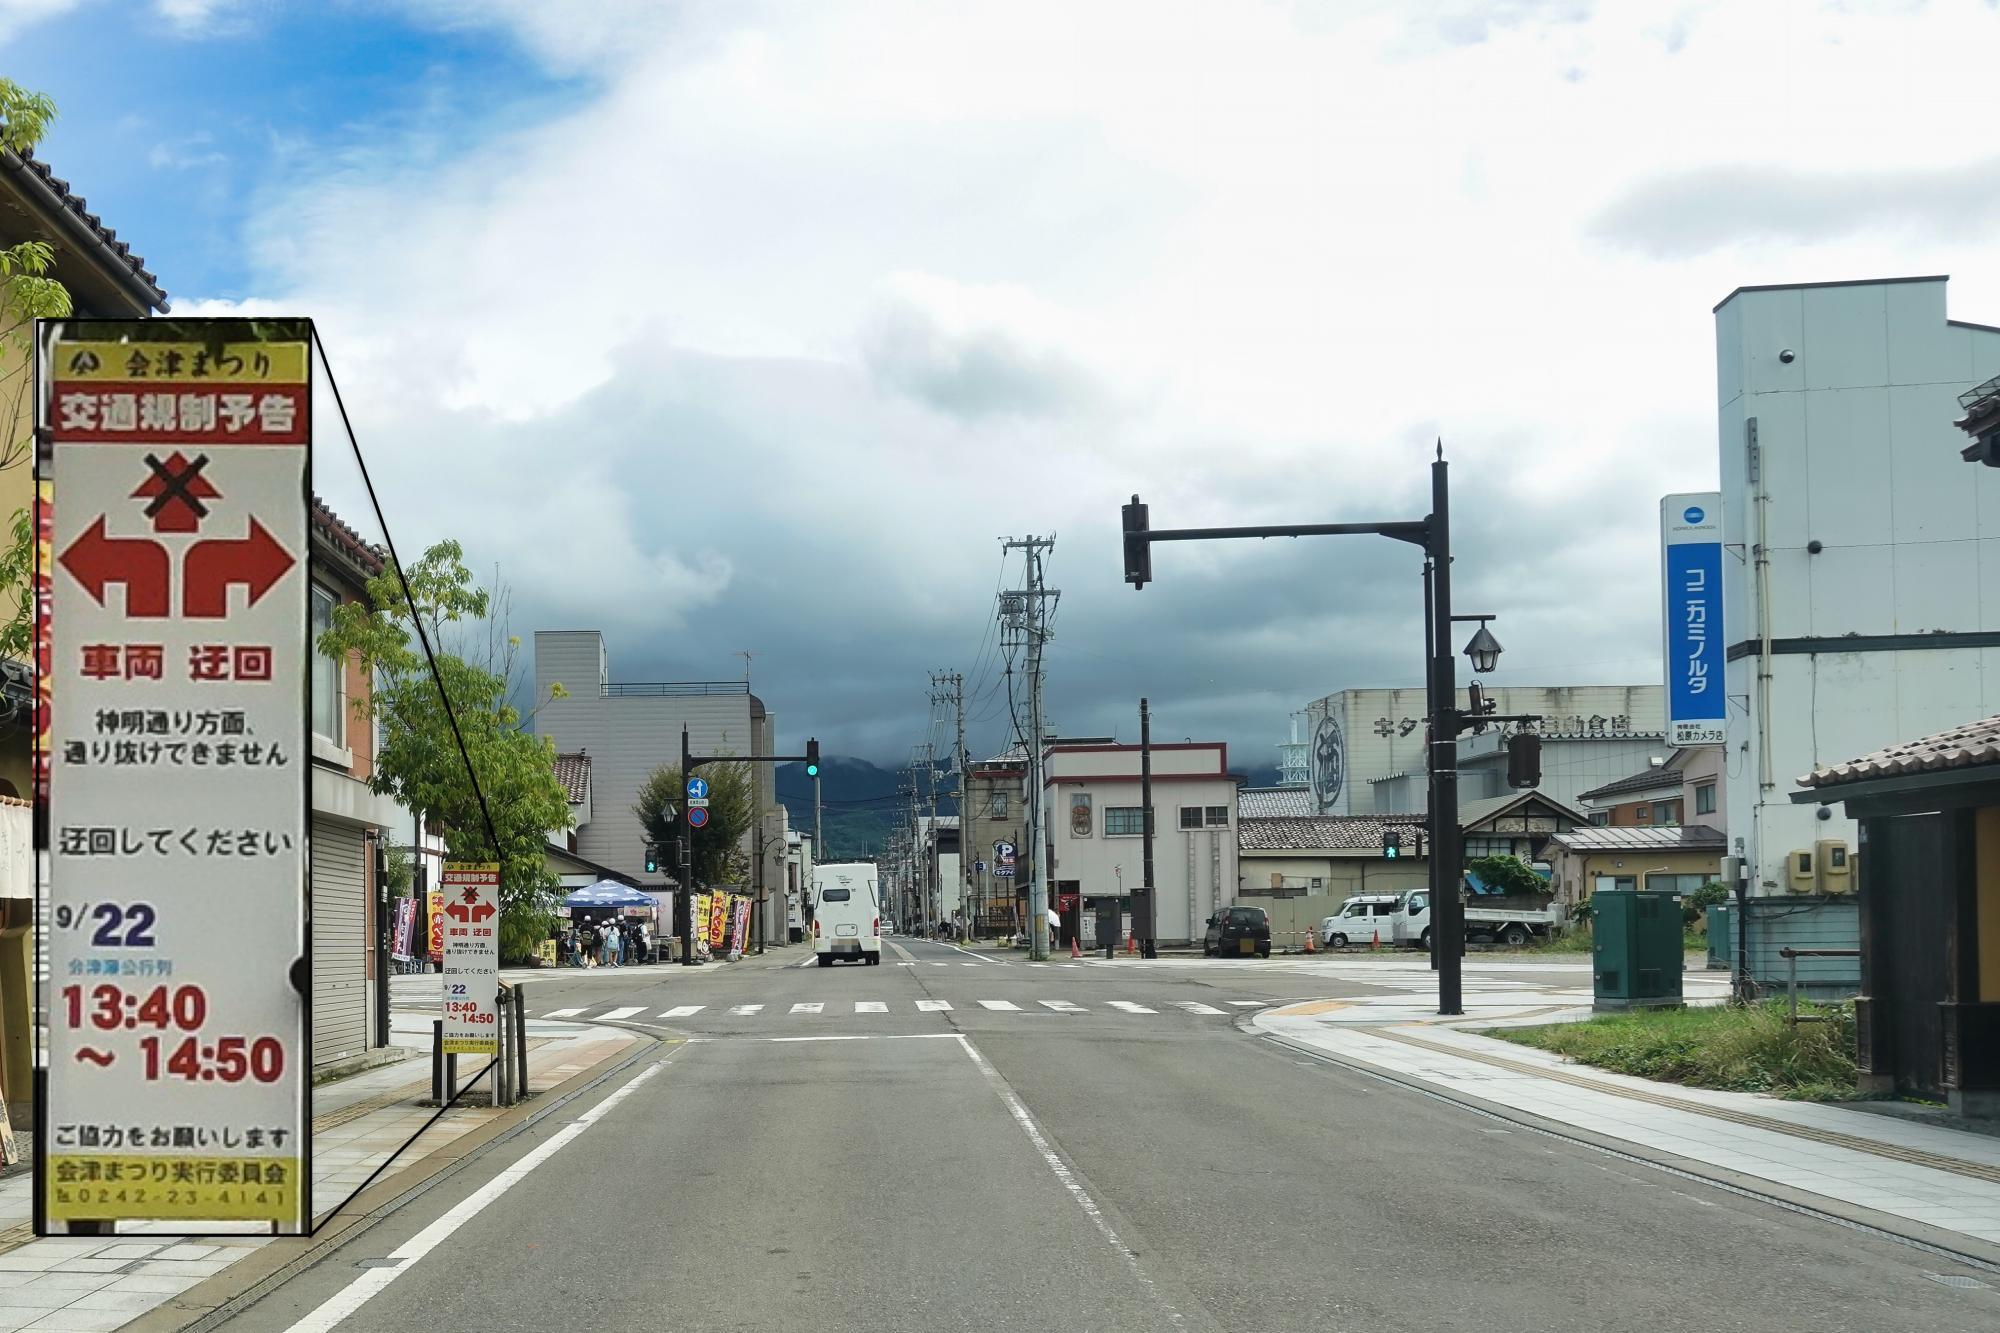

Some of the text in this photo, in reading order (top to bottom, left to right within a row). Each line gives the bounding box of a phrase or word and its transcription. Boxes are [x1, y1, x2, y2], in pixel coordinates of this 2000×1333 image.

[125, 351, 270, 378] 会津まつり
[60, 393, 297, 432] 交通規制予告
[1686, 568, 1709, 694] コニカミノルタ
[81, 644, 272, 681] 車両 迂回
[96, 709, 253, 735] 神明通り方面、
[1677, 730, 1723, 741] 松原カメラ店
[64, 740, 288, 765] 通り抜けできません
[59, 827, 292, 855] 迂回してください
[56, 903, 156, 947] 9/22
[450, 928, 492, 937] 車両 迂回
[63, 984, 206, 1031] 13:40
[446, 1002, 477, 1012] 13:40
[463, 1013, 494, 1024] 14:50
[140, 1037, 284, 1083] 14:50
[56, 1125, 289, 1148] ご協力をお願いします
[57, 1161, 287, 1185] 会津まつり実行委員会
